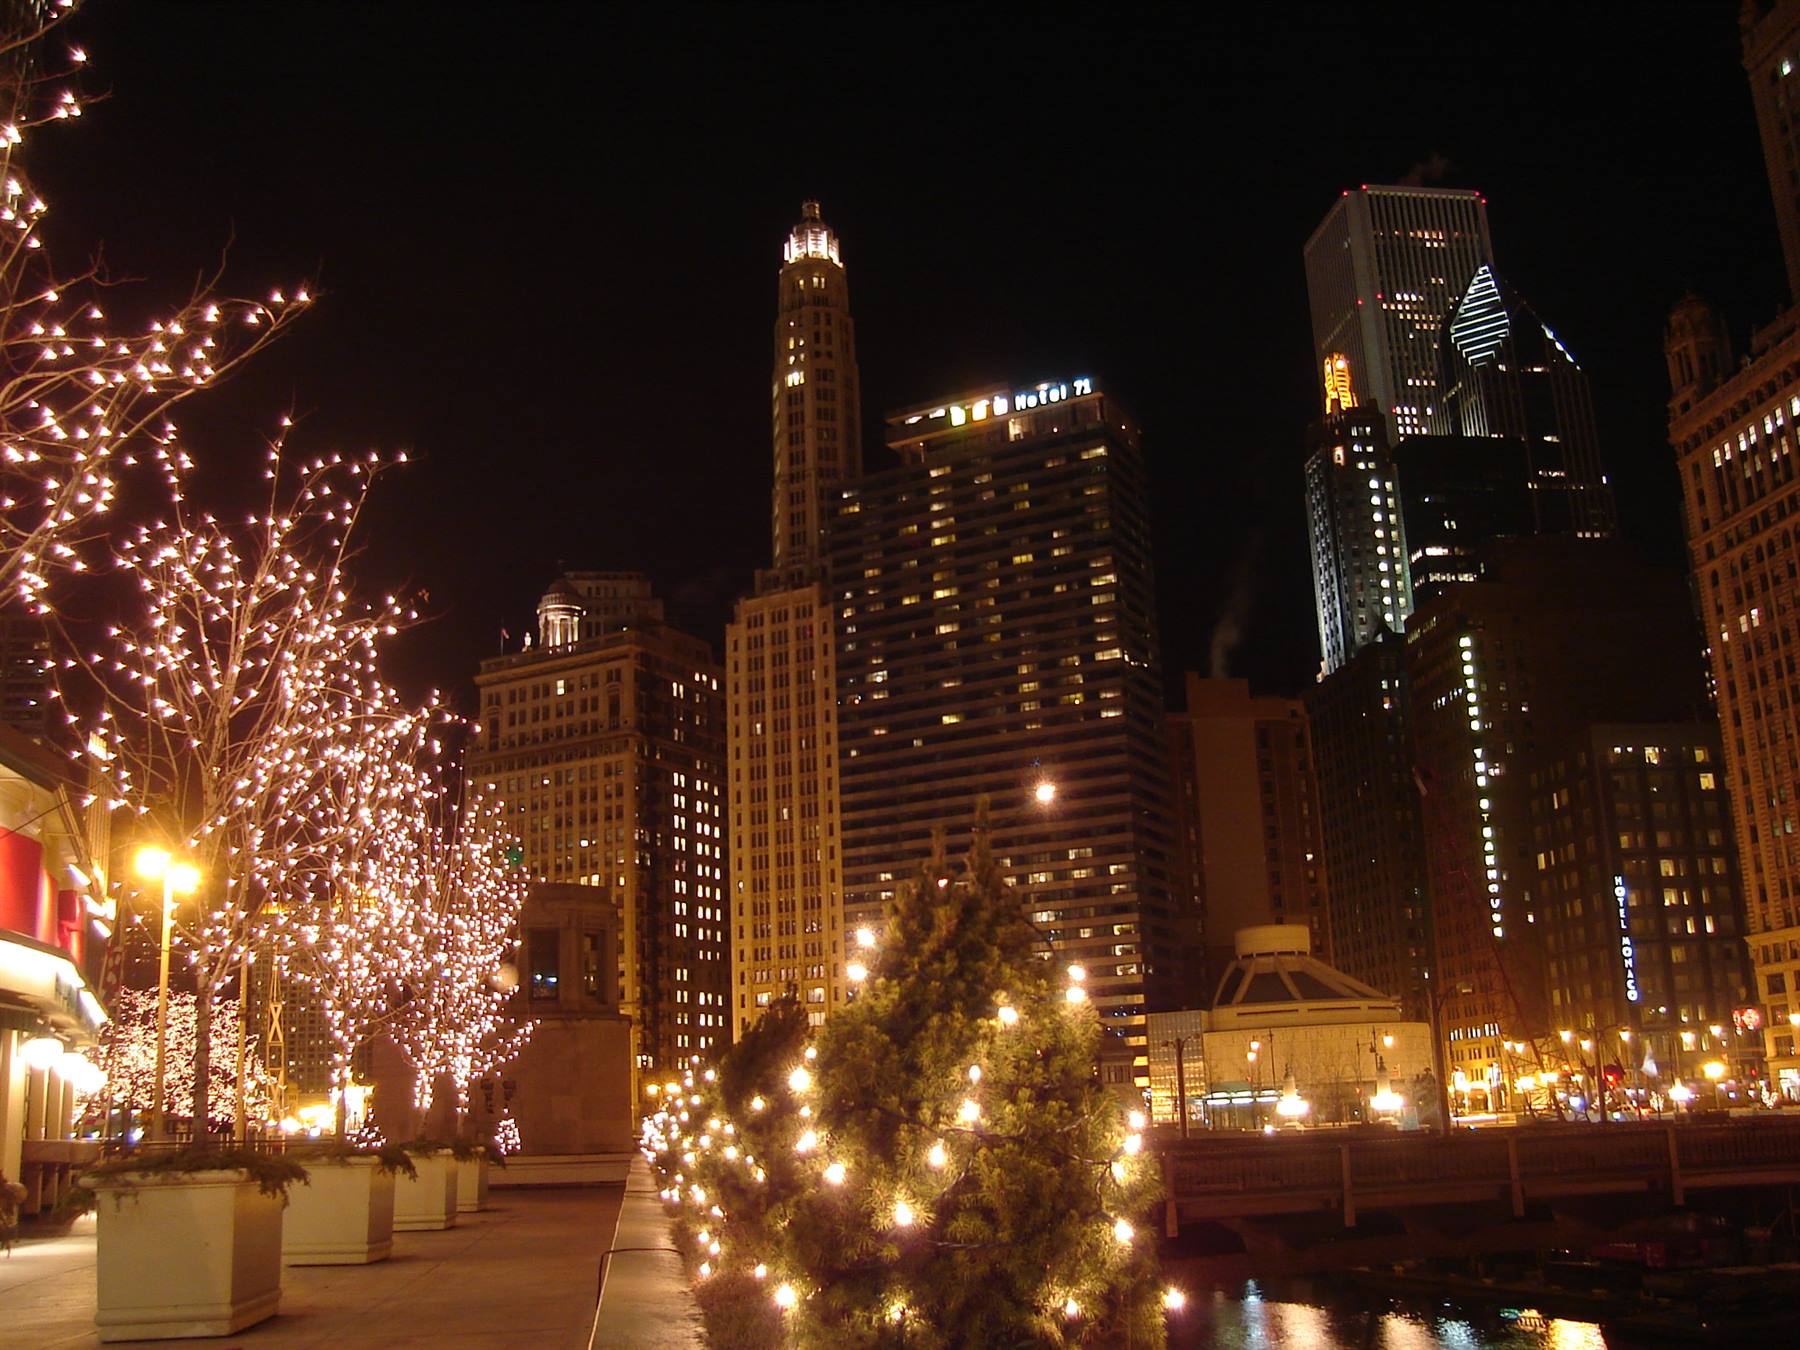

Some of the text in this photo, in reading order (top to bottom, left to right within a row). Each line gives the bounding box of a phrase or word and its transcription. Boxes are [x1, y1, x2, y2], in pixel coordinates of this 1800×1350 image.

[1073, 378, 1092, 396] 71
[1614, 875, 1638, 1002] HOTEL MONACO
